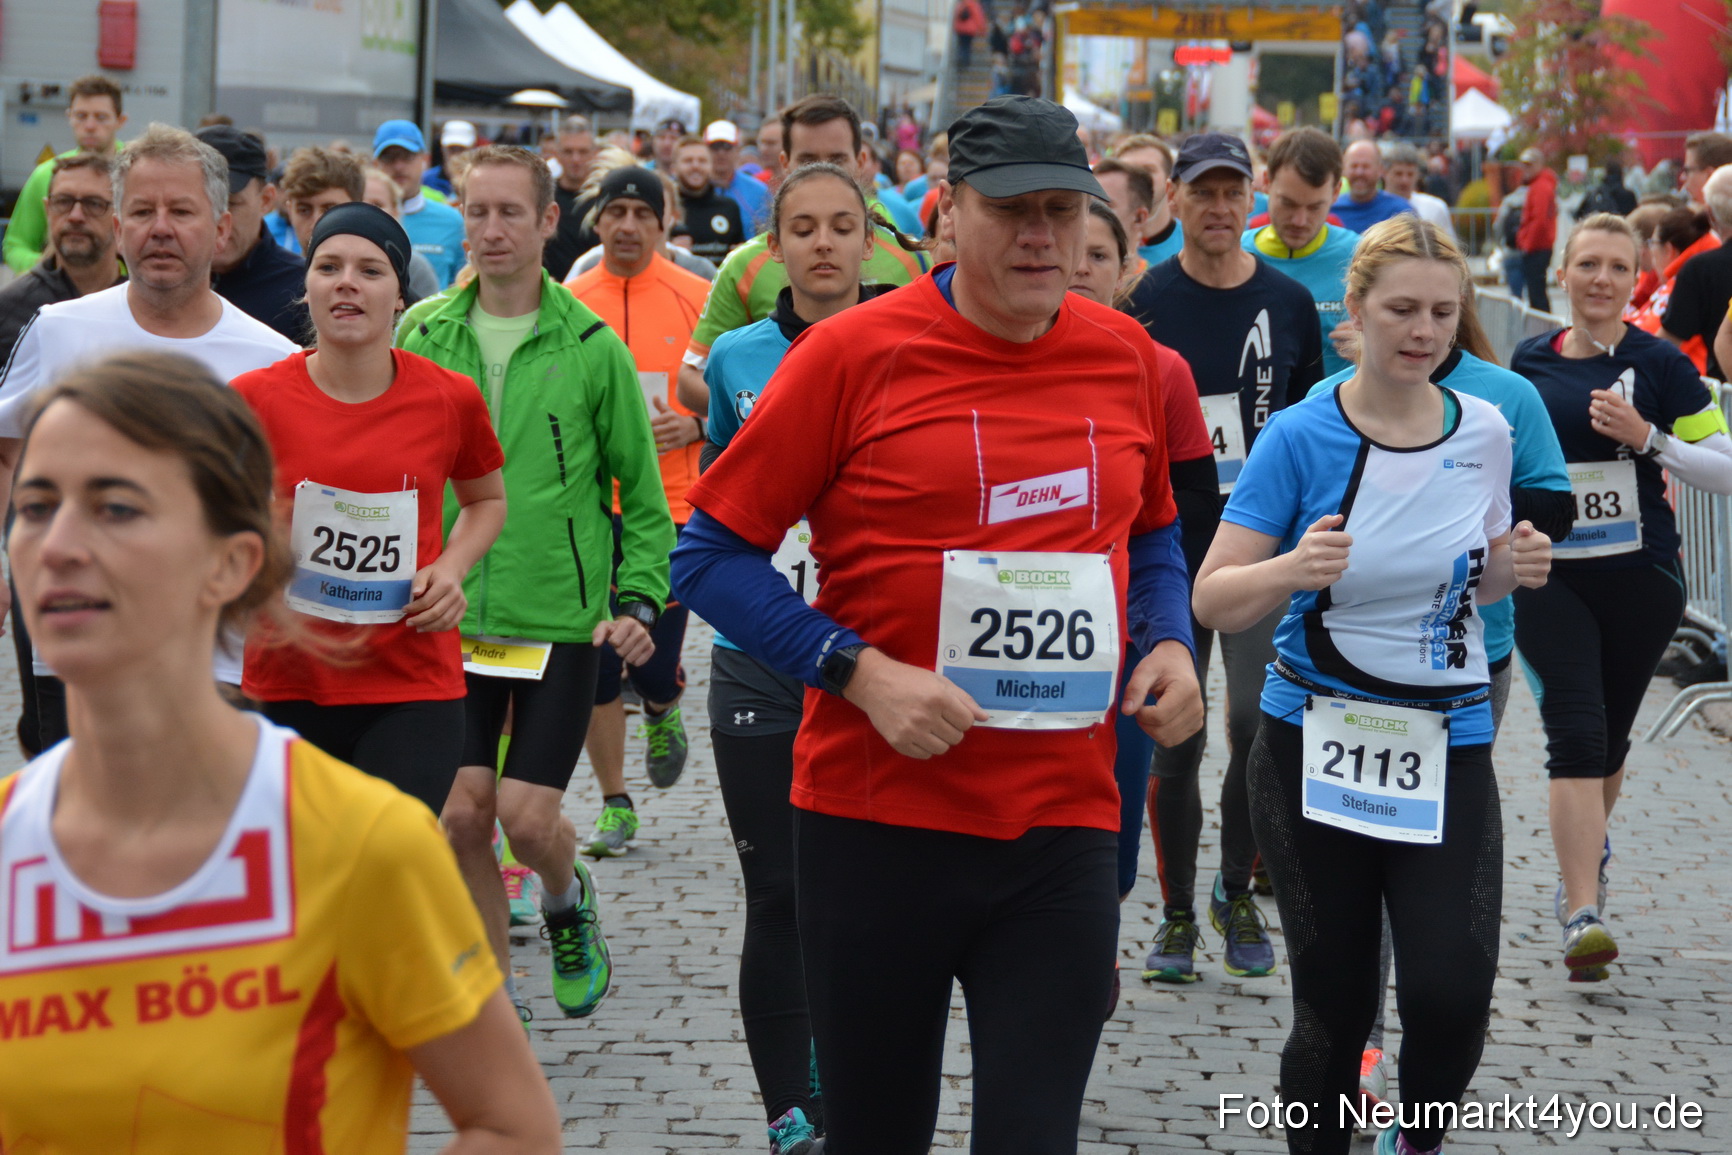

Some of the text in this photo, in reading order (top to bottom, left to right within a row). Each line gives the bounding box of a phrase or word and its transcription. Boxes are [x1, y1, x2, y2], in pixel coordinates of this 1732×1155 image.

[1253, 365, 1273, 428] ONE
[1016, 484, 1062, 508] DEHN
[348, 504, 391, 518] BOCK
[1567, 529, 1607, 542] Daniela
[309, 525, 401, 573] 2525
[1014, 570, 1071, 585] BOCK
[319, 581, 383, 602] Katharina
[968, 607, 1095, 661] 2526
[471, 645, 507, 660] André
[995, 679, 1066, 699] Michael
[1358, 714, 1409, 732] BOCK
[1321, 740, 1422, 791] 2113
[1341, 793, 1398, 817] Stefanie
[0, 964, 301, 1041] MAX BÖGL
